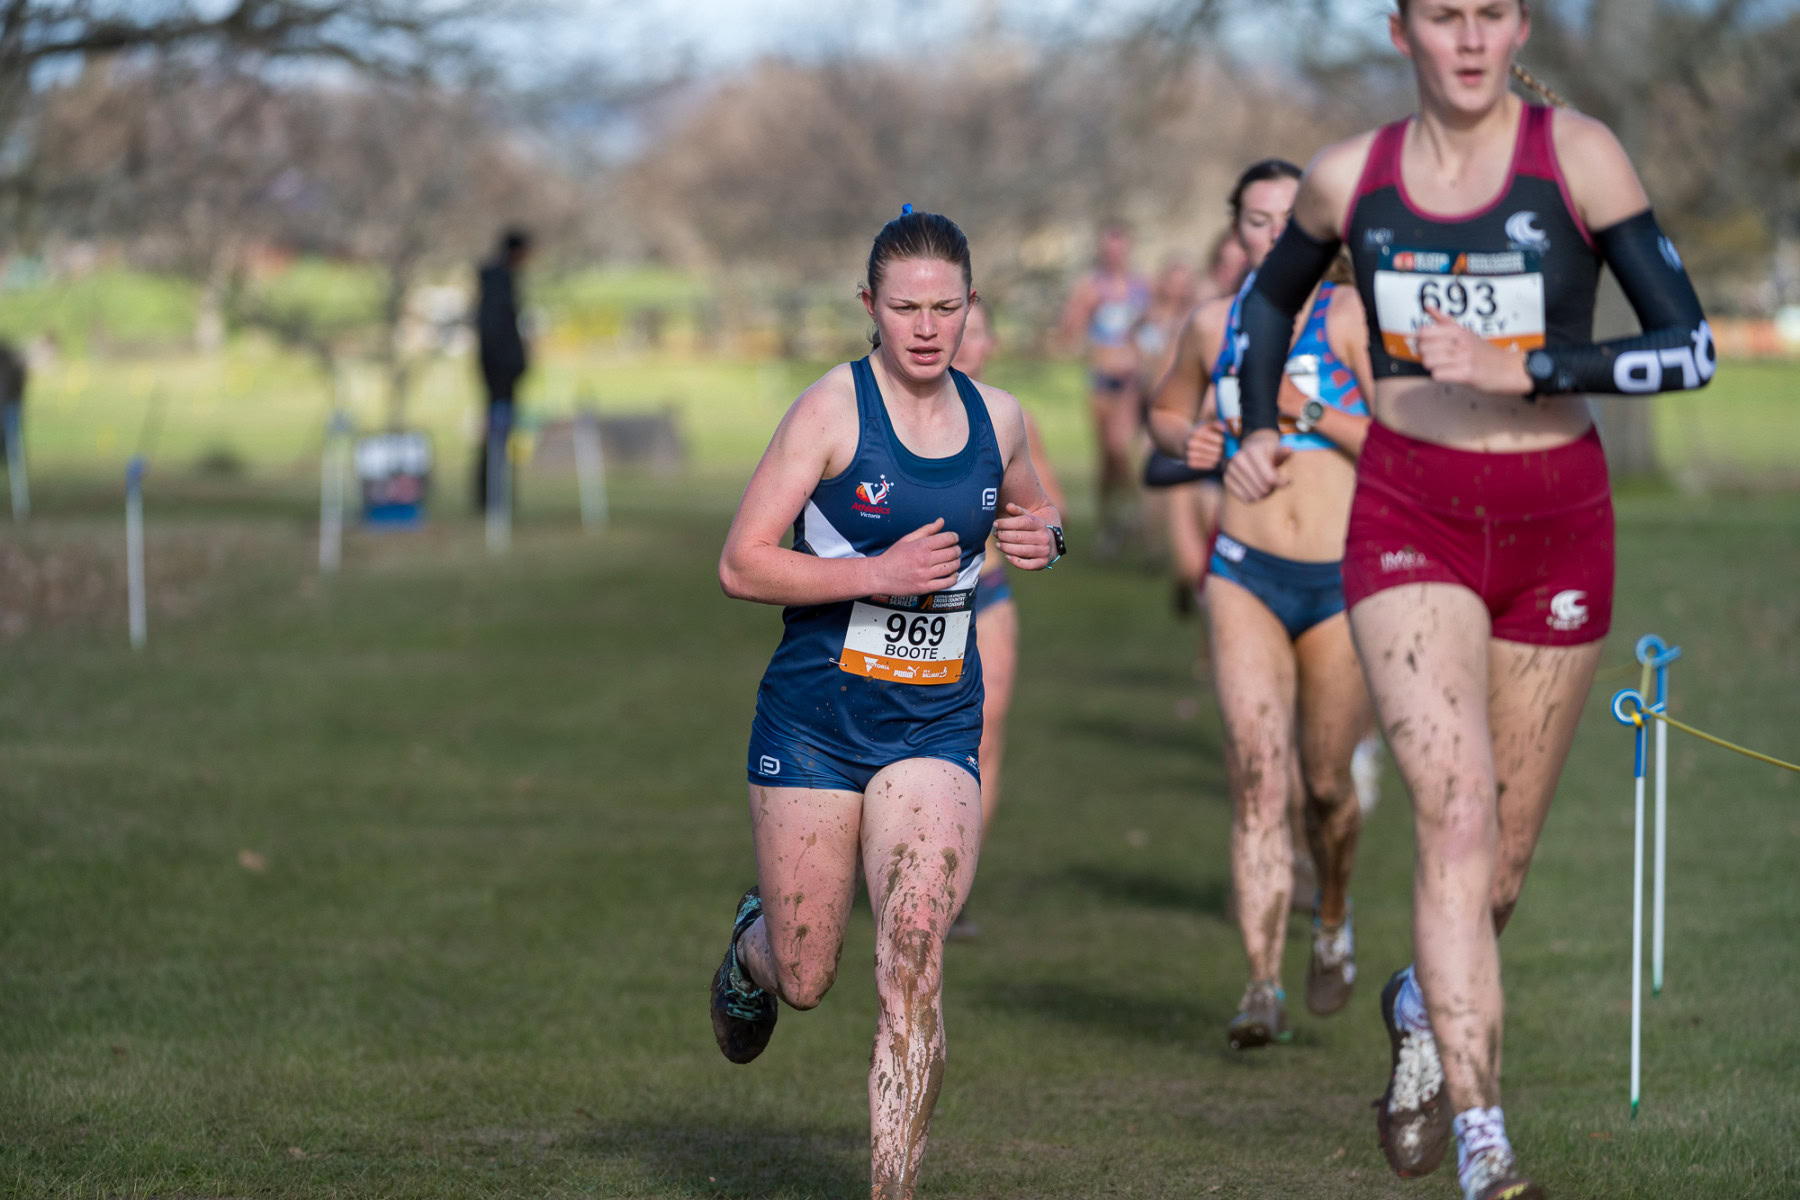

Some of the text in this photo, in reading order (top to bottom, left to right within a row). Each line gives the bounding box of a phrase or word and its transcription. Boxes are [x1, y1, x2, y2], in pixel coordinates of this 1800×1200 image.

[1418, 281, 1497, 317] 693
[851, 502, 890, 514] Athletics
[860, 511, 881, 519] Victoria
[884, 612, 946, 647] 969
[884, 643, 939, 660] BOOTE
